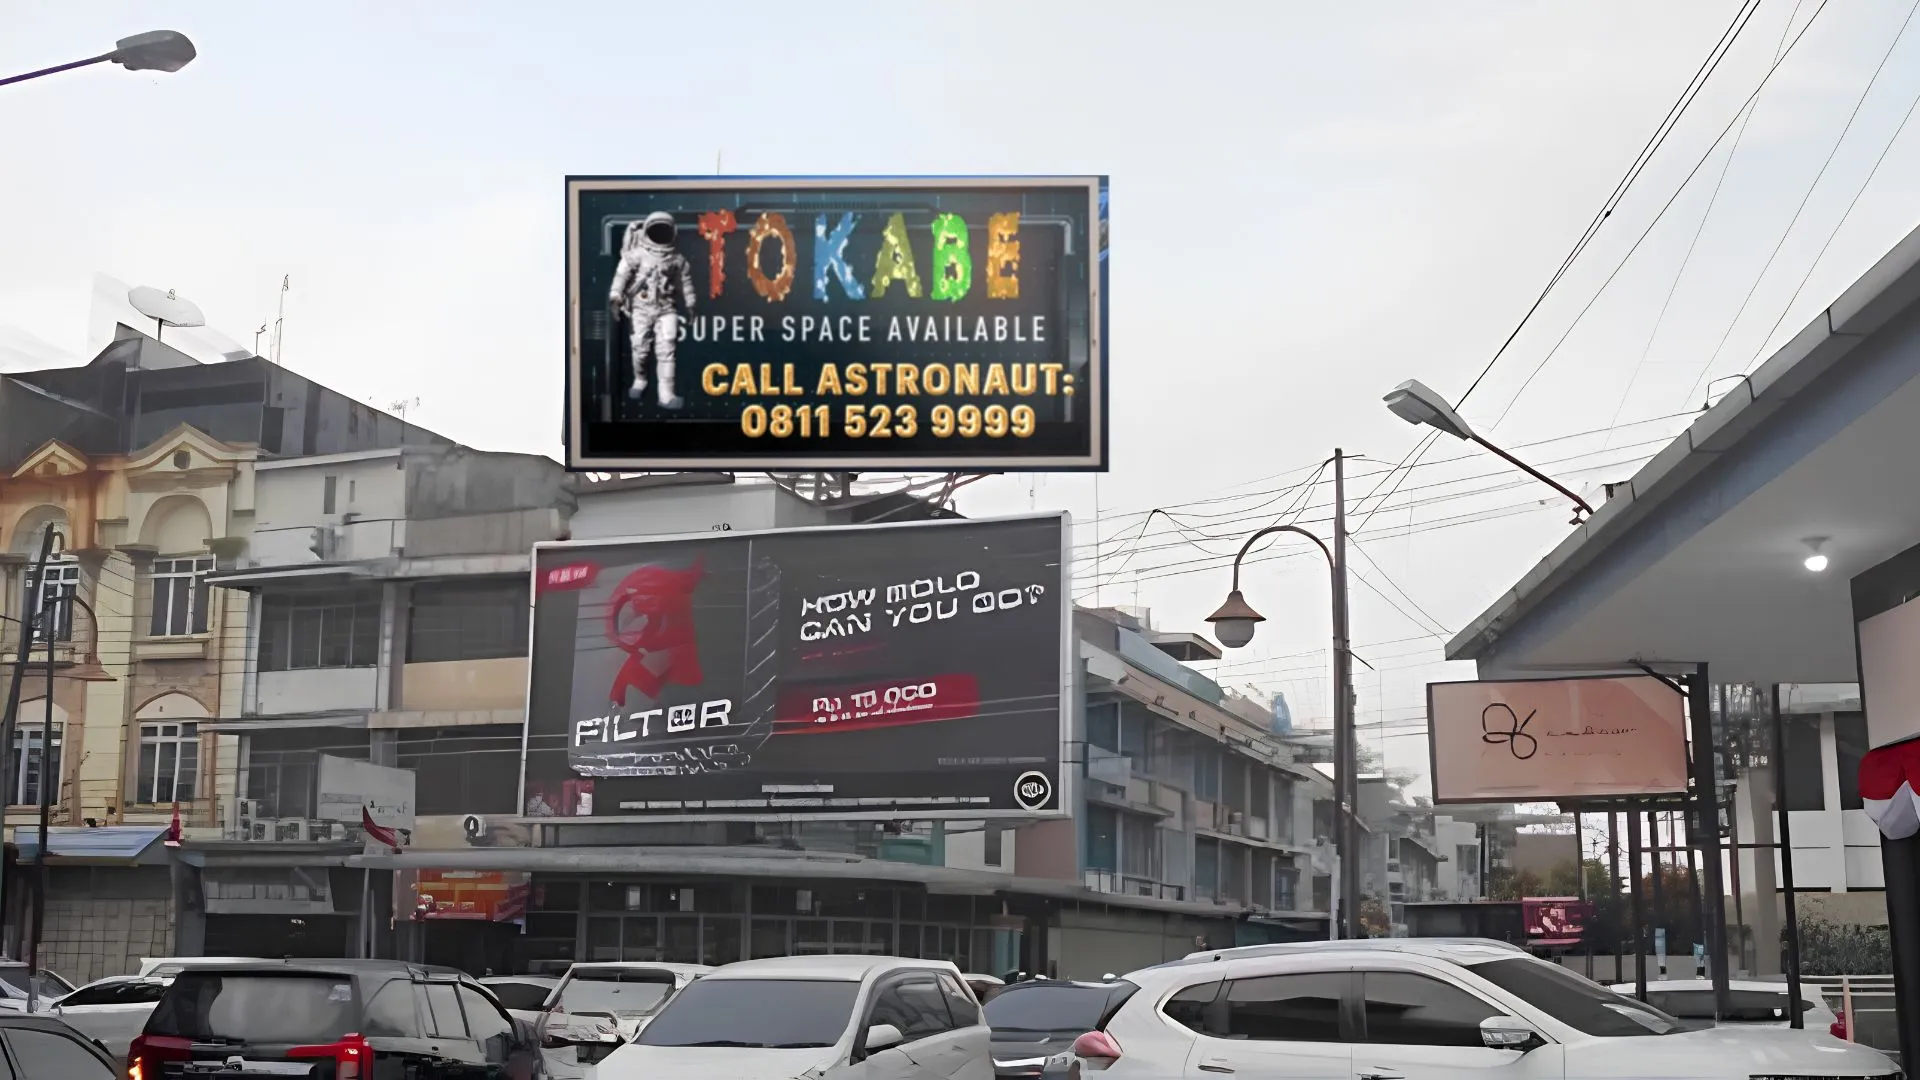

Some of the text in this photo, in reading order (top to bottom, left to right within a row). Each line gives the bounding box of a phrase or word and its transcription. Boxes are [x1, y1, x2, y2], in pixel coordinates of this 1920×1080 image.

[697, 208, 1021, 303] TOKABE
[677, 314, 1046, 342] SUPER SPACE AVAILABLE
[702, 362, 1075, 397] CALL ASTRONAUT:
[741, 403, 1036, 438] 0811 523 9999
[885, 597, 958, 627] YOU
